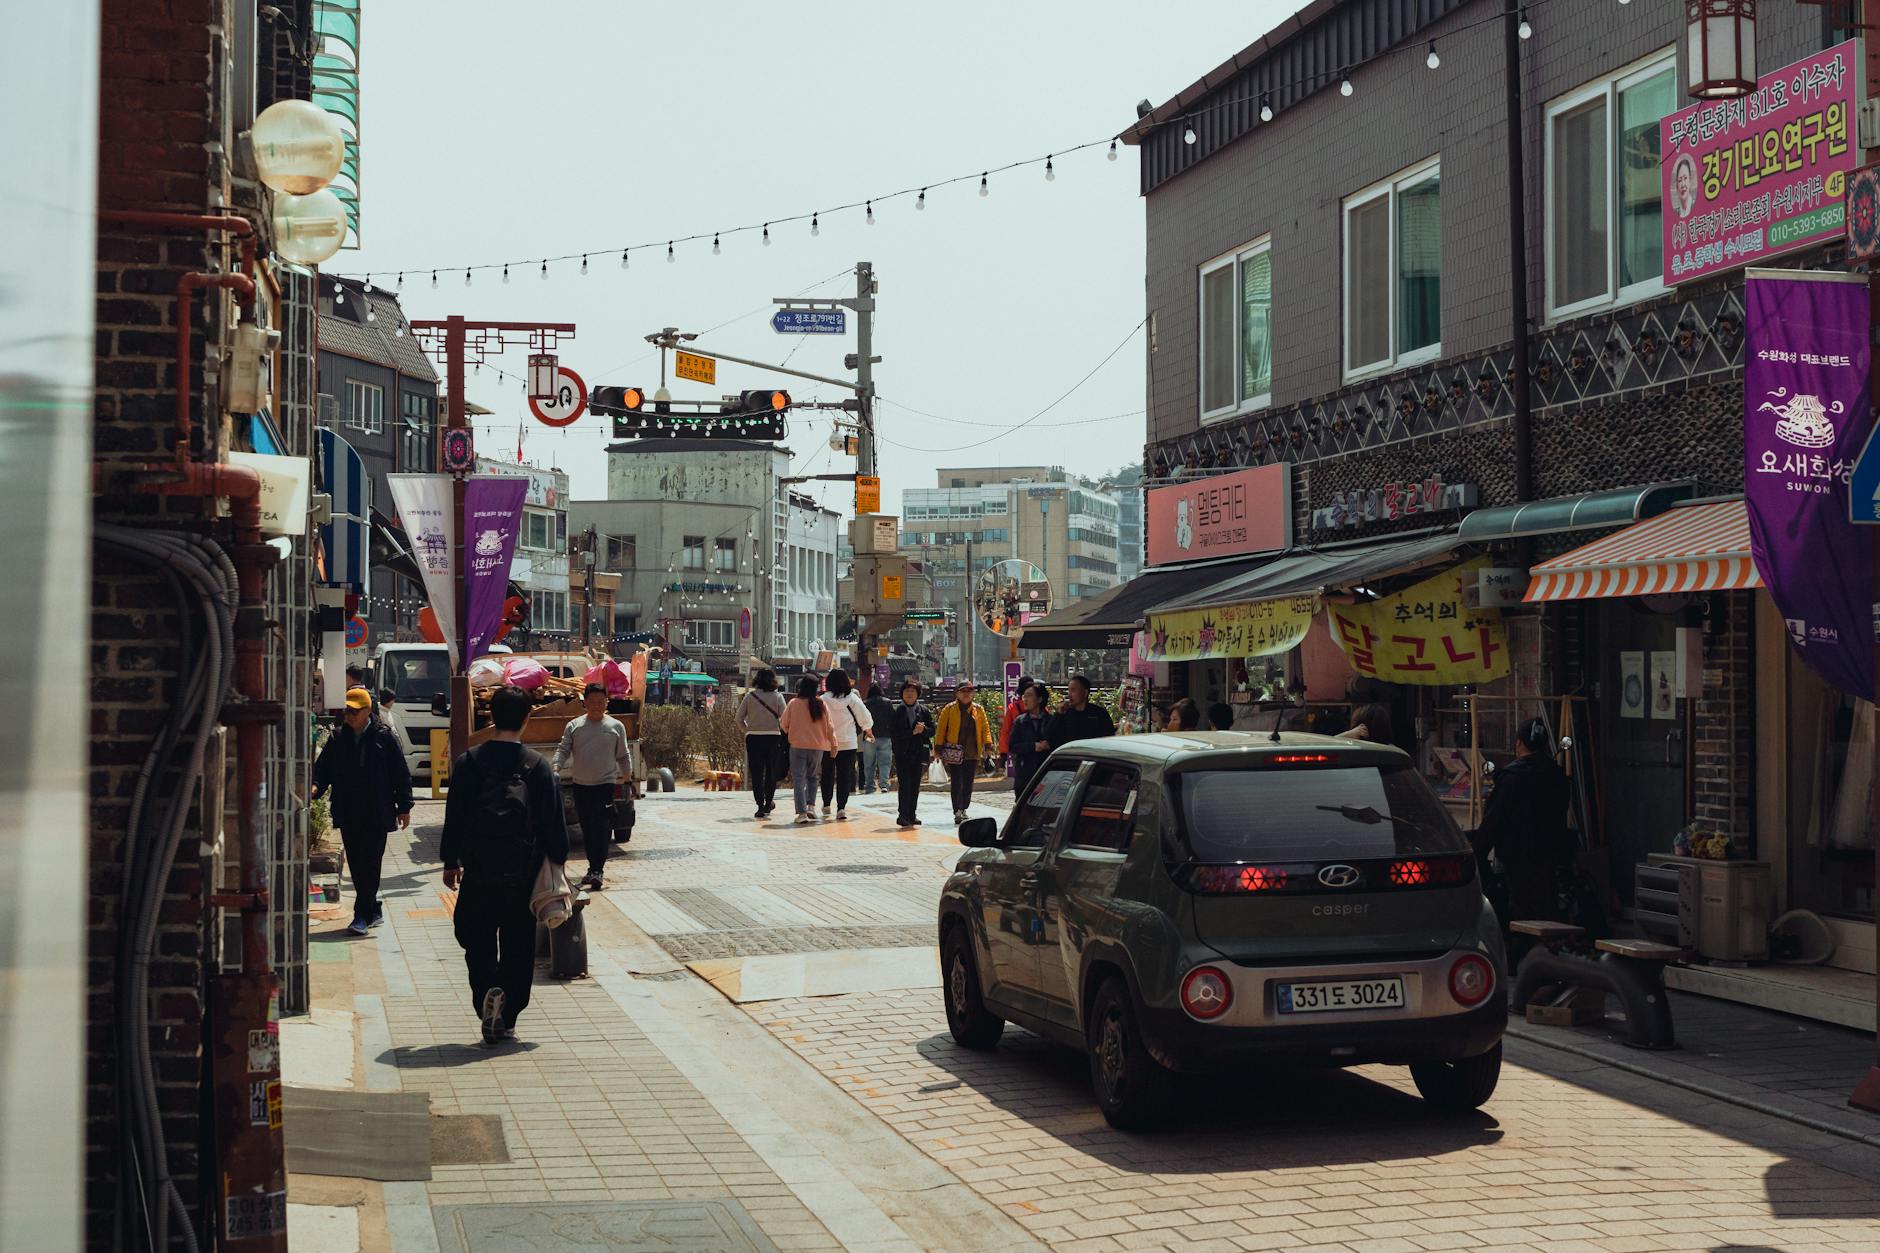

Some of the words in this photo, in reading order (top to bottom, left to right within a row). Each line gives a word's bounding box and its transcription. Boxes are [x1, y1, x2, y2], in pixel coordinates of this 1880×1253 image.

[1669, 97, 1746, 152] 무형문화재
[1750, 81, 1788, 120] 31호
[1791, 53, 1846, 101] 이수자
[1702, 100, 1848, 200] 경기민요연구원
[1829, 173, 1844, 194] 4F
[1671, 220, 1687, 249] (사)
[1688, 193, 1771, 243] 한국경기소리보존회
[1773, 175, 1824, 218] 수원시지부
[1770, 207, 1845, 242] 010-5393-6850
[794, 313, 843, 324] 정조로791번길
[1757, 349, 1797, 364] 수원화성
[1800, 353, 1851, 367] 대표브랜드
[1383, 474, 1442, 521] 달고나
[1786, 481, 1831, 494] SUWON
[1198, 483, 1247, 526] 멜팅키티
[1394, 601, 1457, 624] 추억의
[1258, 626, 1265, 648] 수
[1335, 613, 1500, 674] 달고나
[1809, 626, 1839, 640] 수원시
[1312, 903, 1371, 917] casper
[1294, 986, 1346, 1008] 331도
[1350, 983, 1398, 1005] 3024
